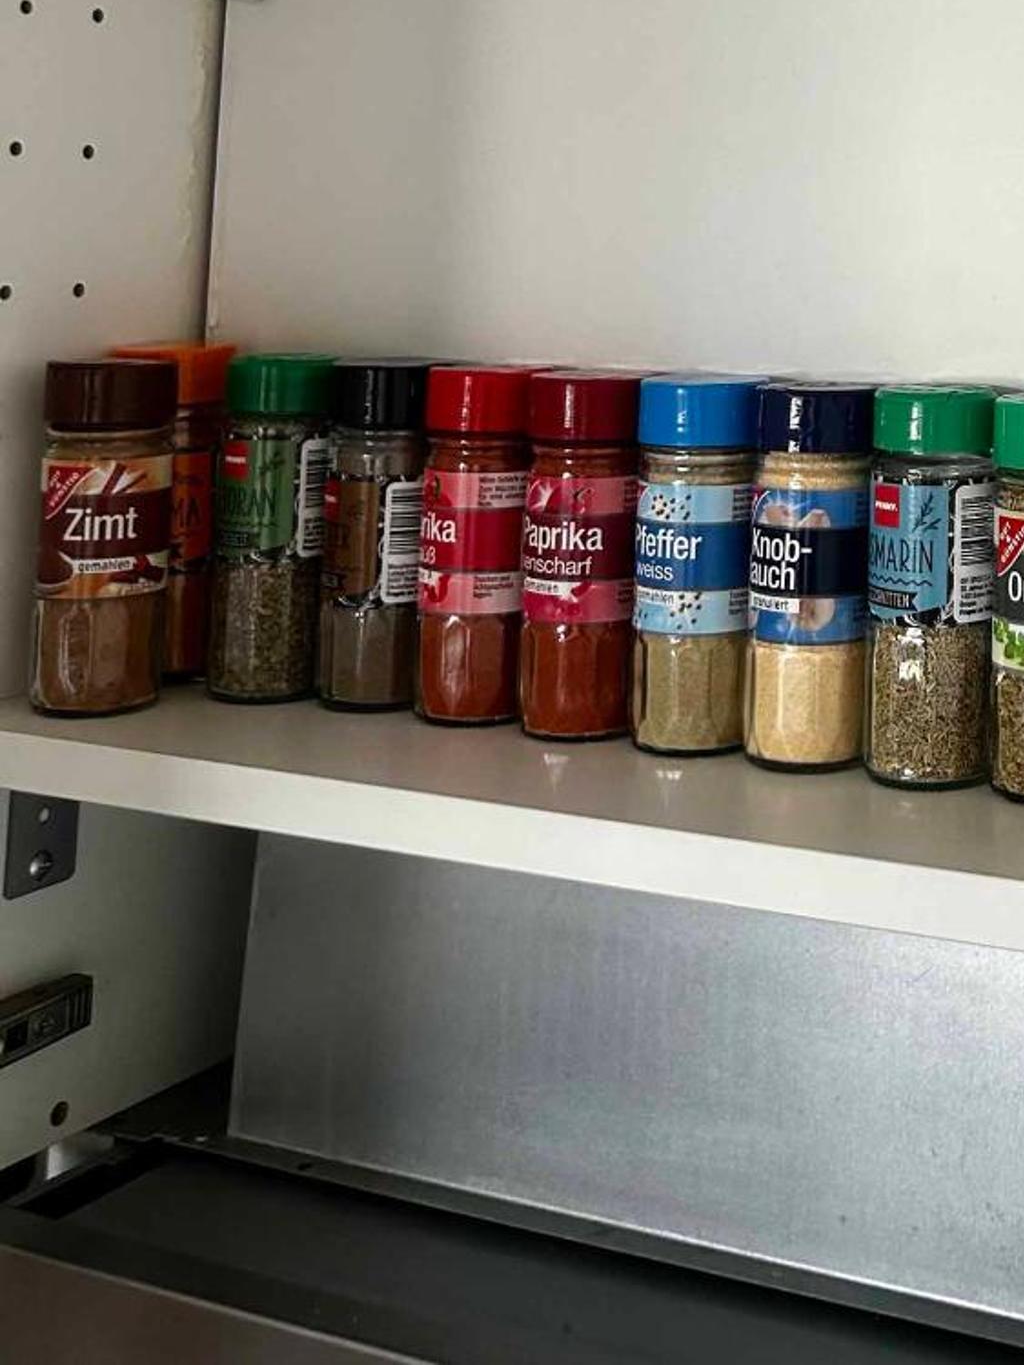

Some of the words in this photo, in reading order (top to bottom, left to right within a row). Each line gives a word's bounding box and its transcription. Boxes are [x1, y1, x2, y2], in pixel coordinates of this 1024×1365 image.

[63, 506, 139, 542] Zimt
[524, 517, 603, 553] Paprika
[636, 523, 702, 560] Pfeffer
[752, 528, 813, 562] Knob-
[78, 559, 131, 573] gemahlen
[636, 560, 674, 581] weiss
